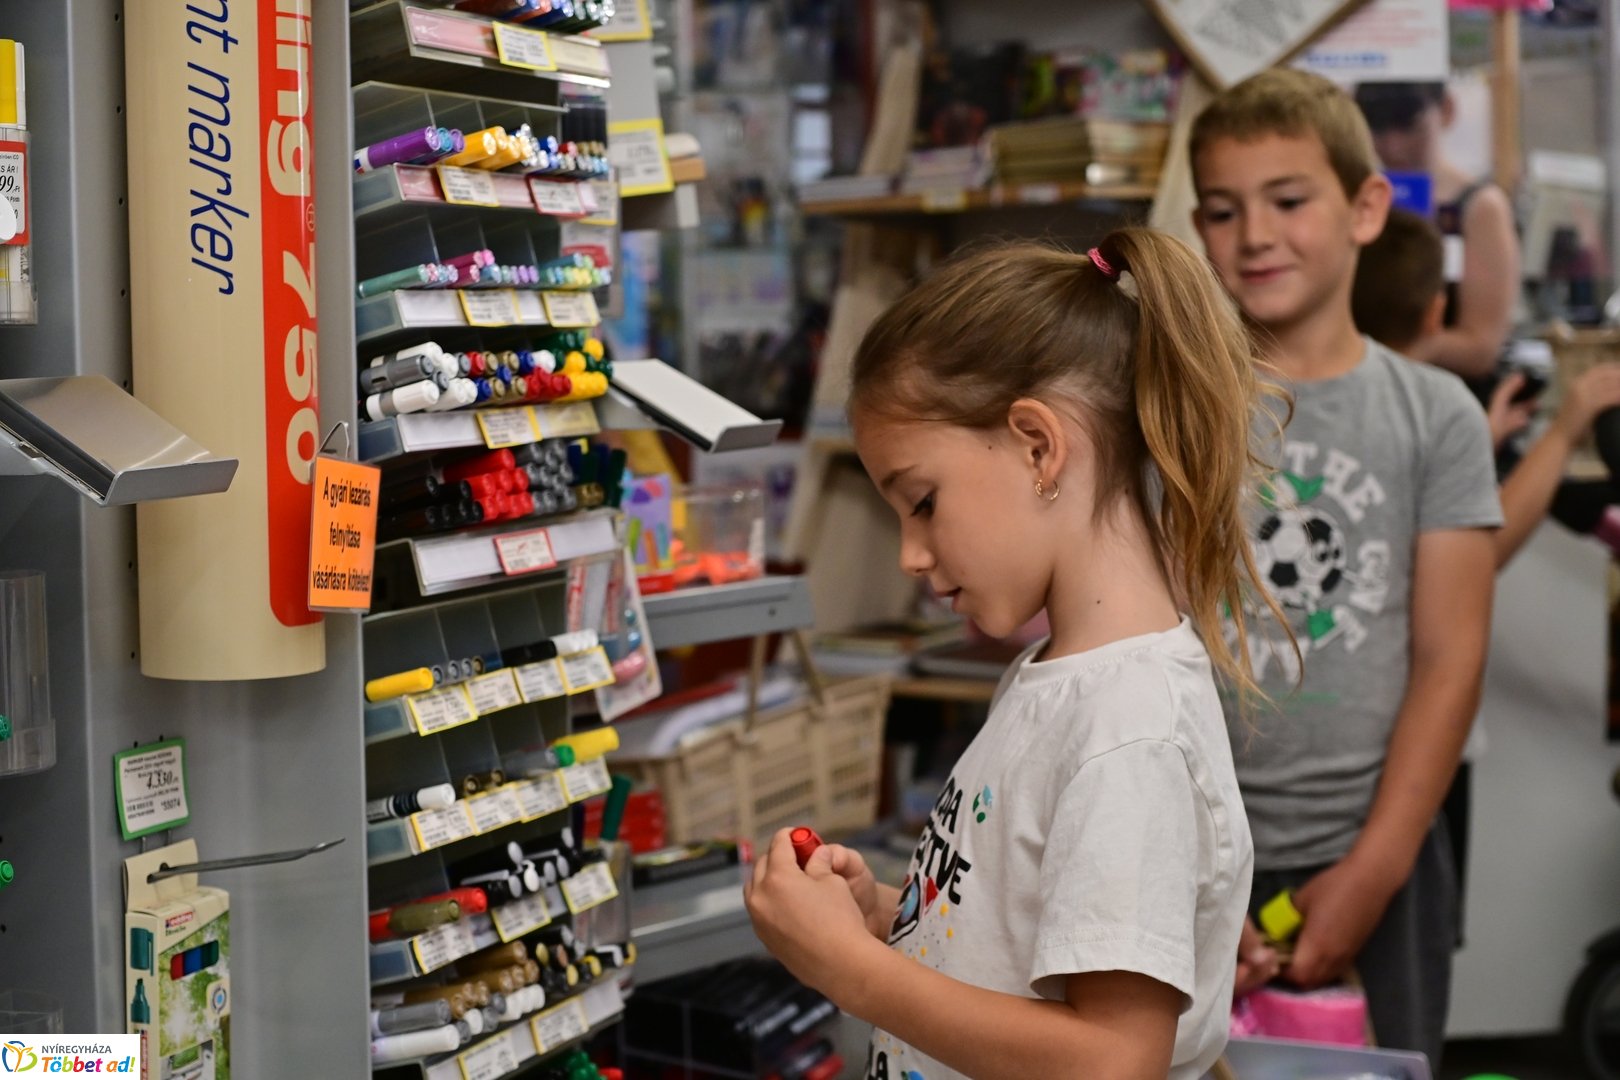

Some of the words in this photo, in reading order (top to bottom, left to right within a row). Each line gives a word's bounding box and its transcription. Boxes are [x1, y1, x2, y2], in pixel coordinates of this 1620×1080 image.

[267, 0, 312, 198] ing
[187, 61, 250, 296] marker
[283, 242, 320, 486] 750
[323, 476, 329, 500] A
[330, 478, 348, 508] gyári
[349, 481, 371, 507] lezárás
[1285, 441, 1386, 523] THE
[313, 564, 346, 591] vásárlásra
[329, 521, 361, 552] felnyitása
